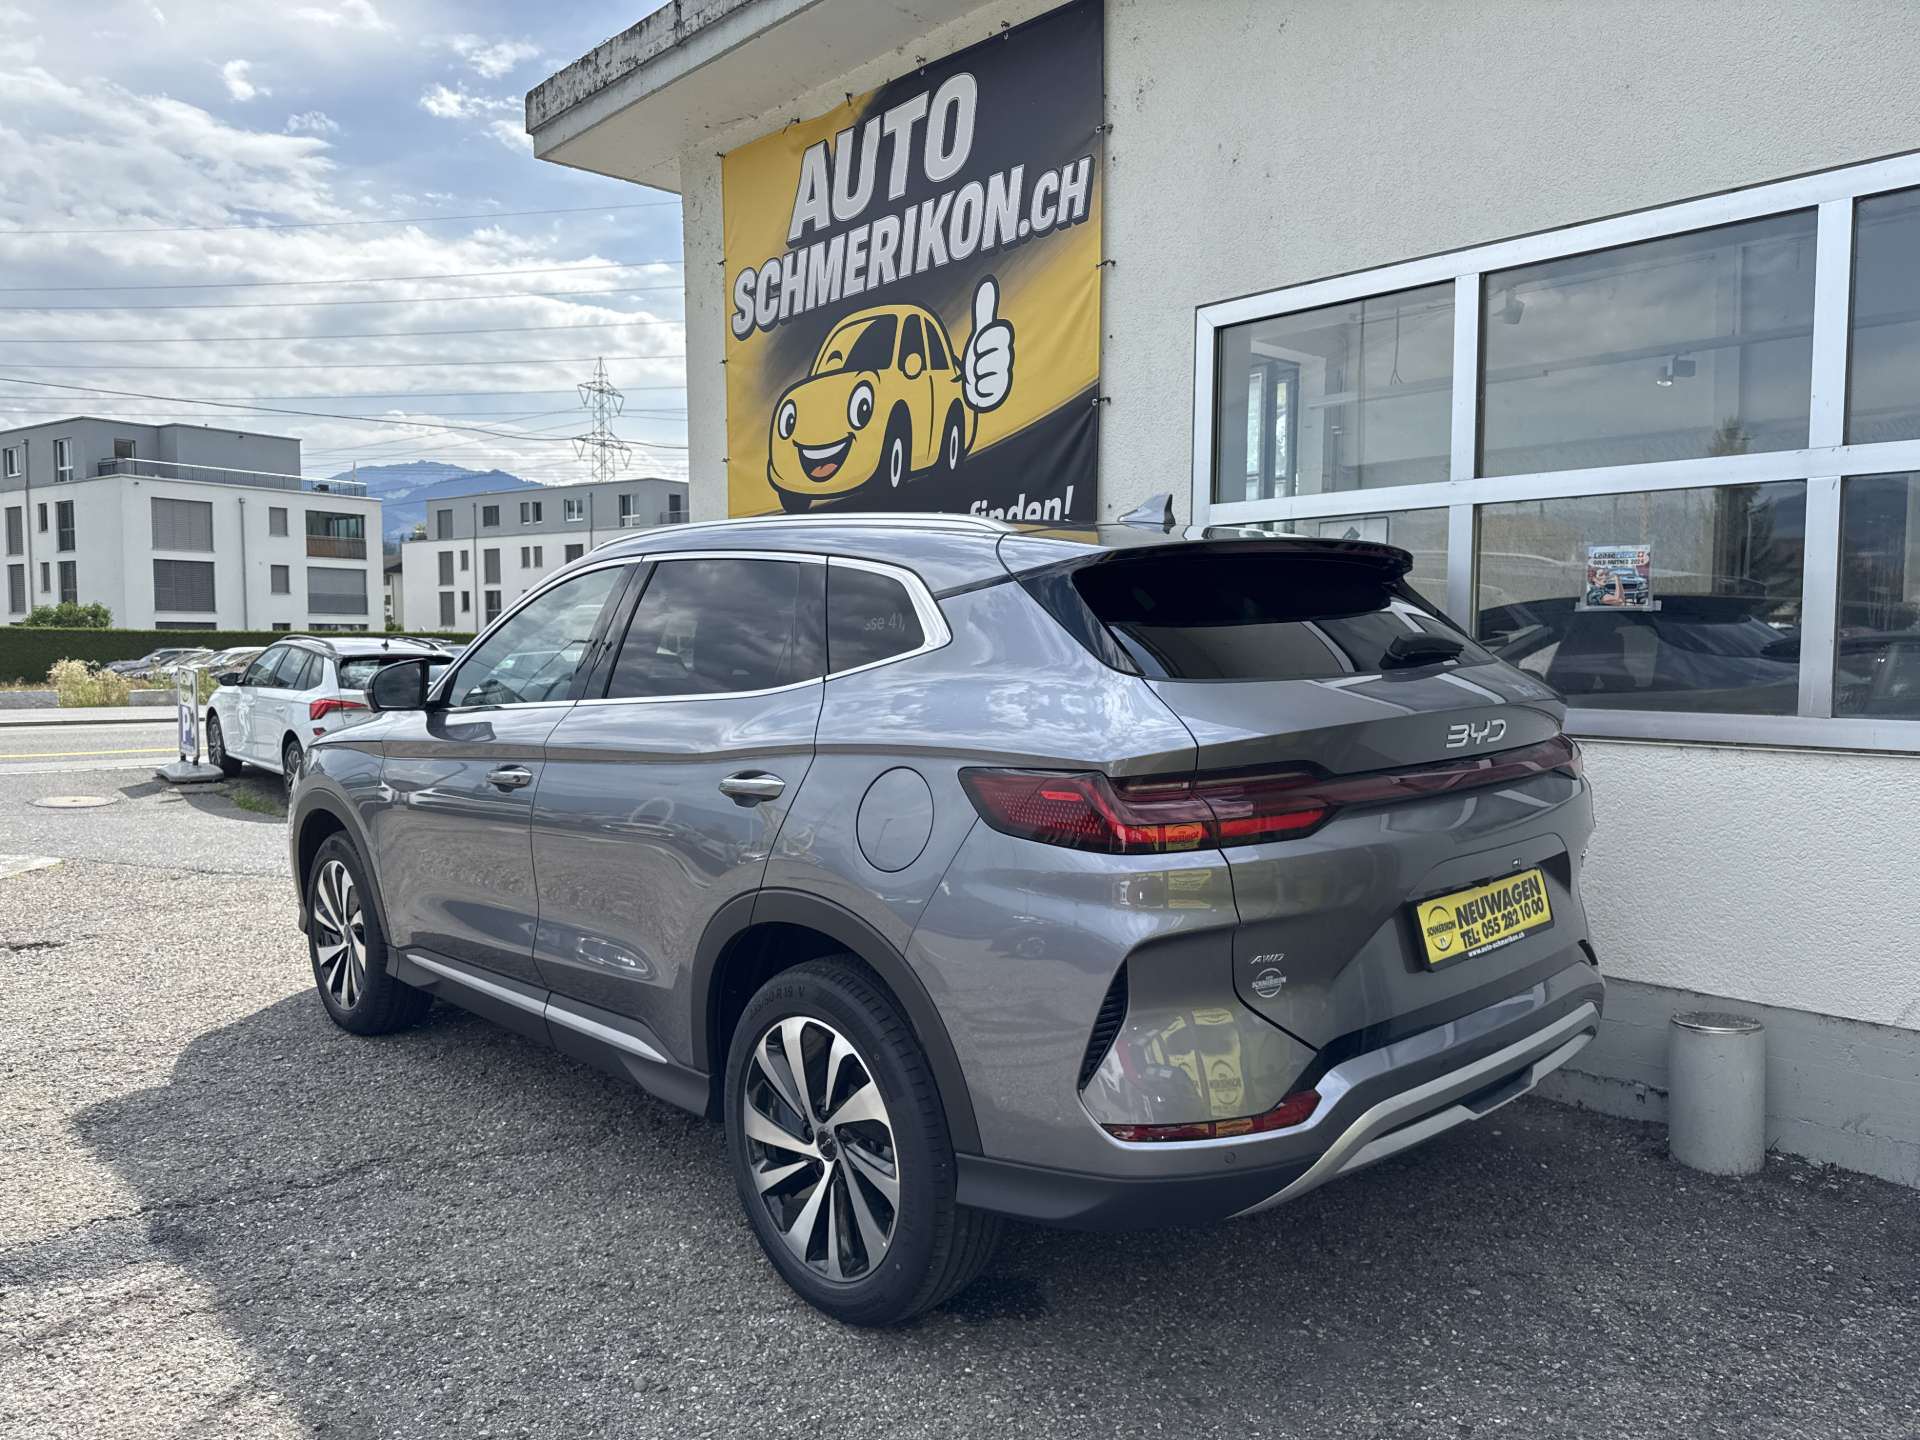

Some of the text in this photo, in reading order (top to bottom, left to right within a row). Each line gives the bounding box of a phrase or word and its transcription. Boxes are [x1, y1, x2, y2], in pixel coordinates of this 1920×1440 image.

[788, 72, 978, 244] AUTO
[731, 157, 1094, 336] SCHMERIKON.CH
[1446, 719, 1507, 748] BYD
[1455, 875, 1542, 930] NEUWAGEN
[1460, 897, 1544, 949] TEL: 055 282 10 00
[1250, 953, 1285, 965] AWD
